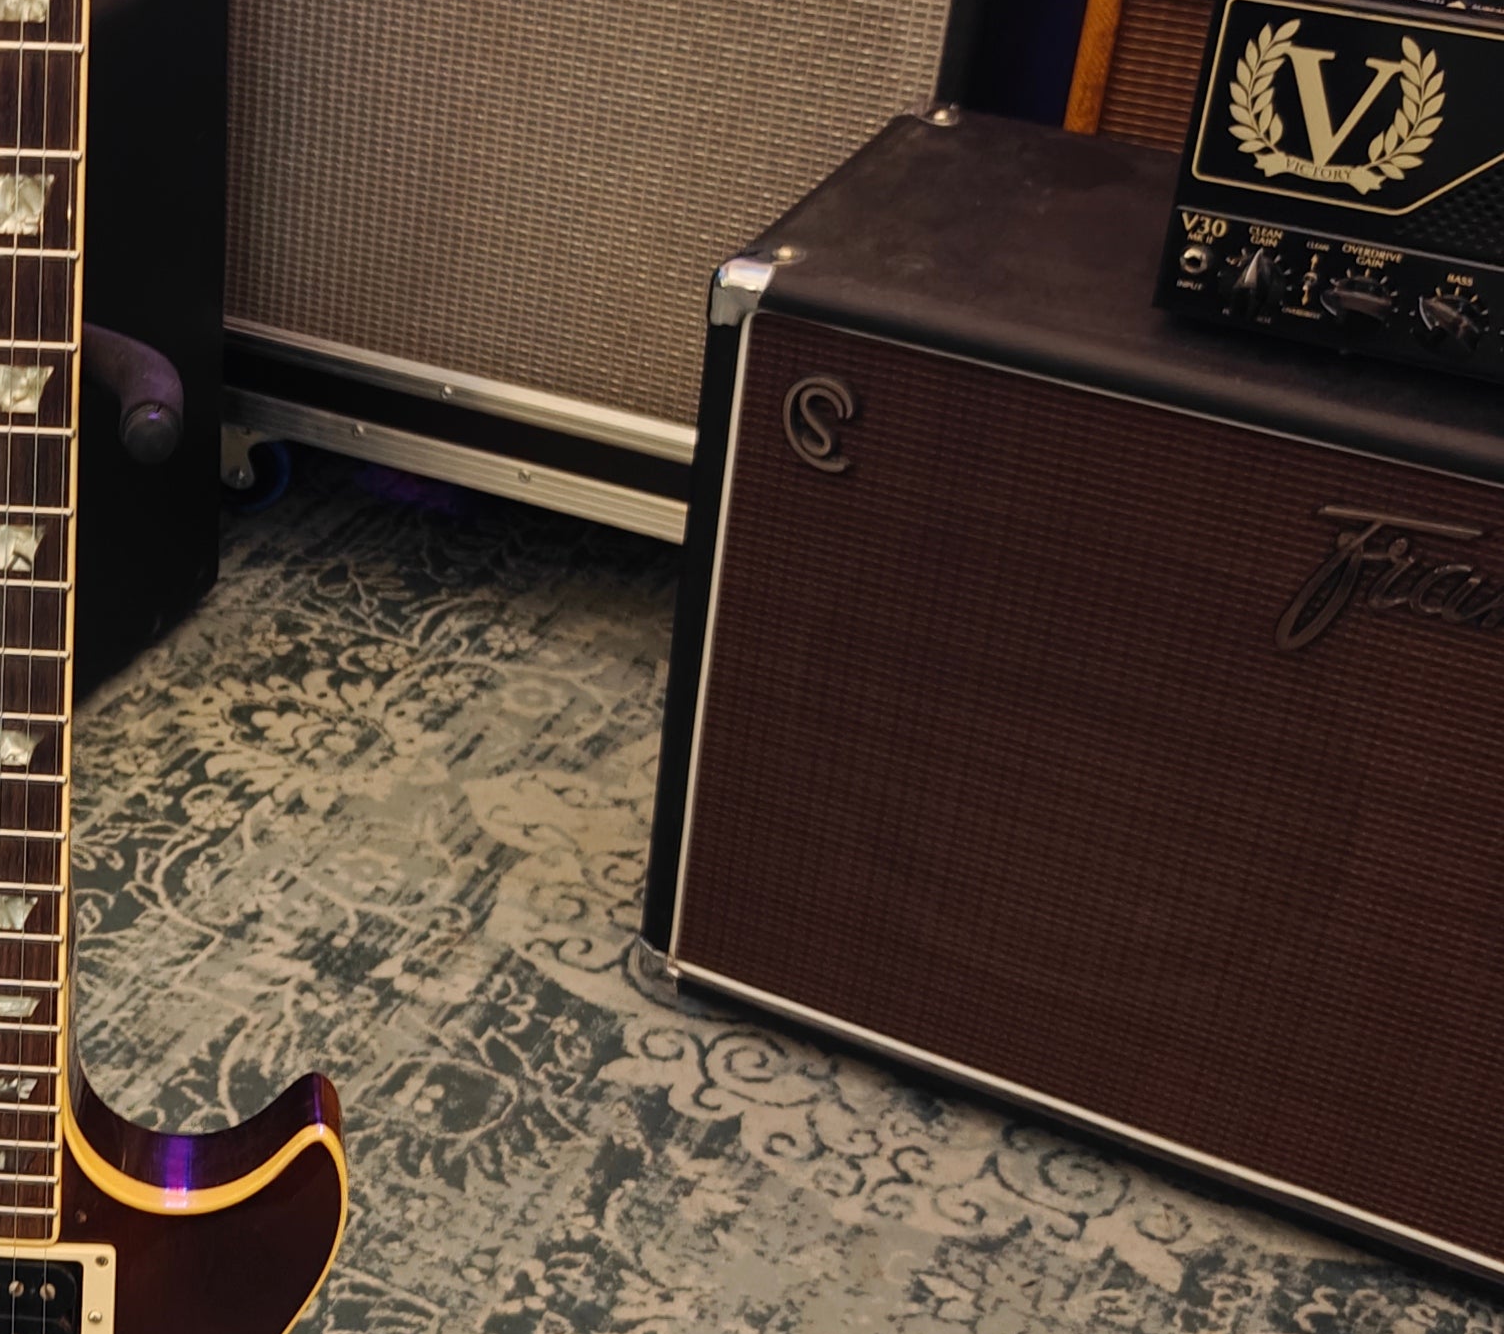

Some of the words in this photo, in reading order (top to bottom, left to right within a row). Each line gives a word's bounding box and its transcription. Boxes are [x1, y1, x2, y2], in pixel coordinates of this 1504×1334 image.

[1285, 157, 1353, 181] VICTORY
[1182, 212, 1228, 238] V30
[1248, 226, 1284, 240] CLEAN
[1250, 237, 1279, 248] GAIN
[1341, 243, 1405, 264] OVERDRIVE
[1356, 256, 1385, 269] GAIN
[1176, 279, 1203, 291] INPUT
[1446, 273, 1474, 287] BASS
